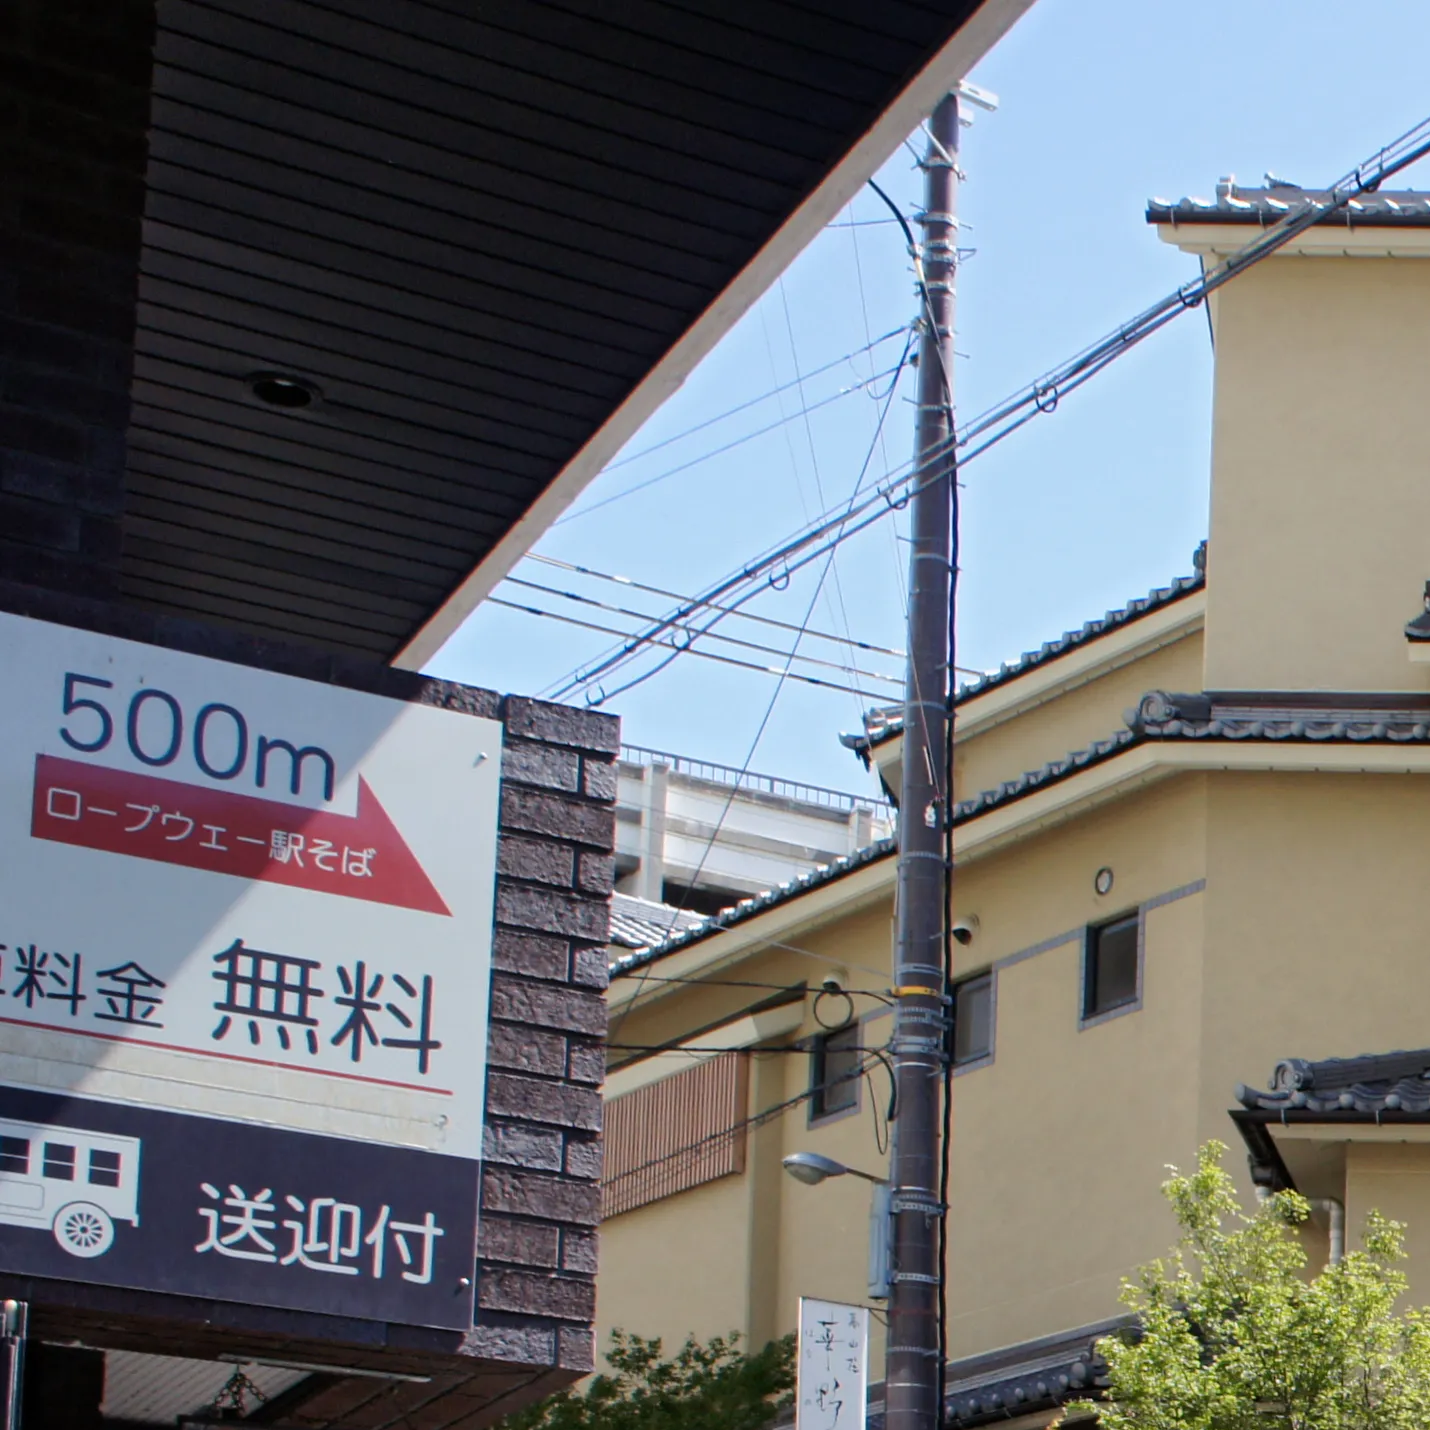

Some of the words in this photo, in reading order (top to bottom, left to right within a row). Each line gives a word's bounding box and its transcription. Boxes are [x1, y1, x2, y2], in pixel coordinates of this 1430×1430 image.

[58, 671, 336, 802] 500m
[47, 786, 377, 879] ロープウェー駅そば
[0, 943, 166, 1031] 料金
[211, 938, 442, 1075] 無料
[195, 1179, 444, 1286] 送迎付
